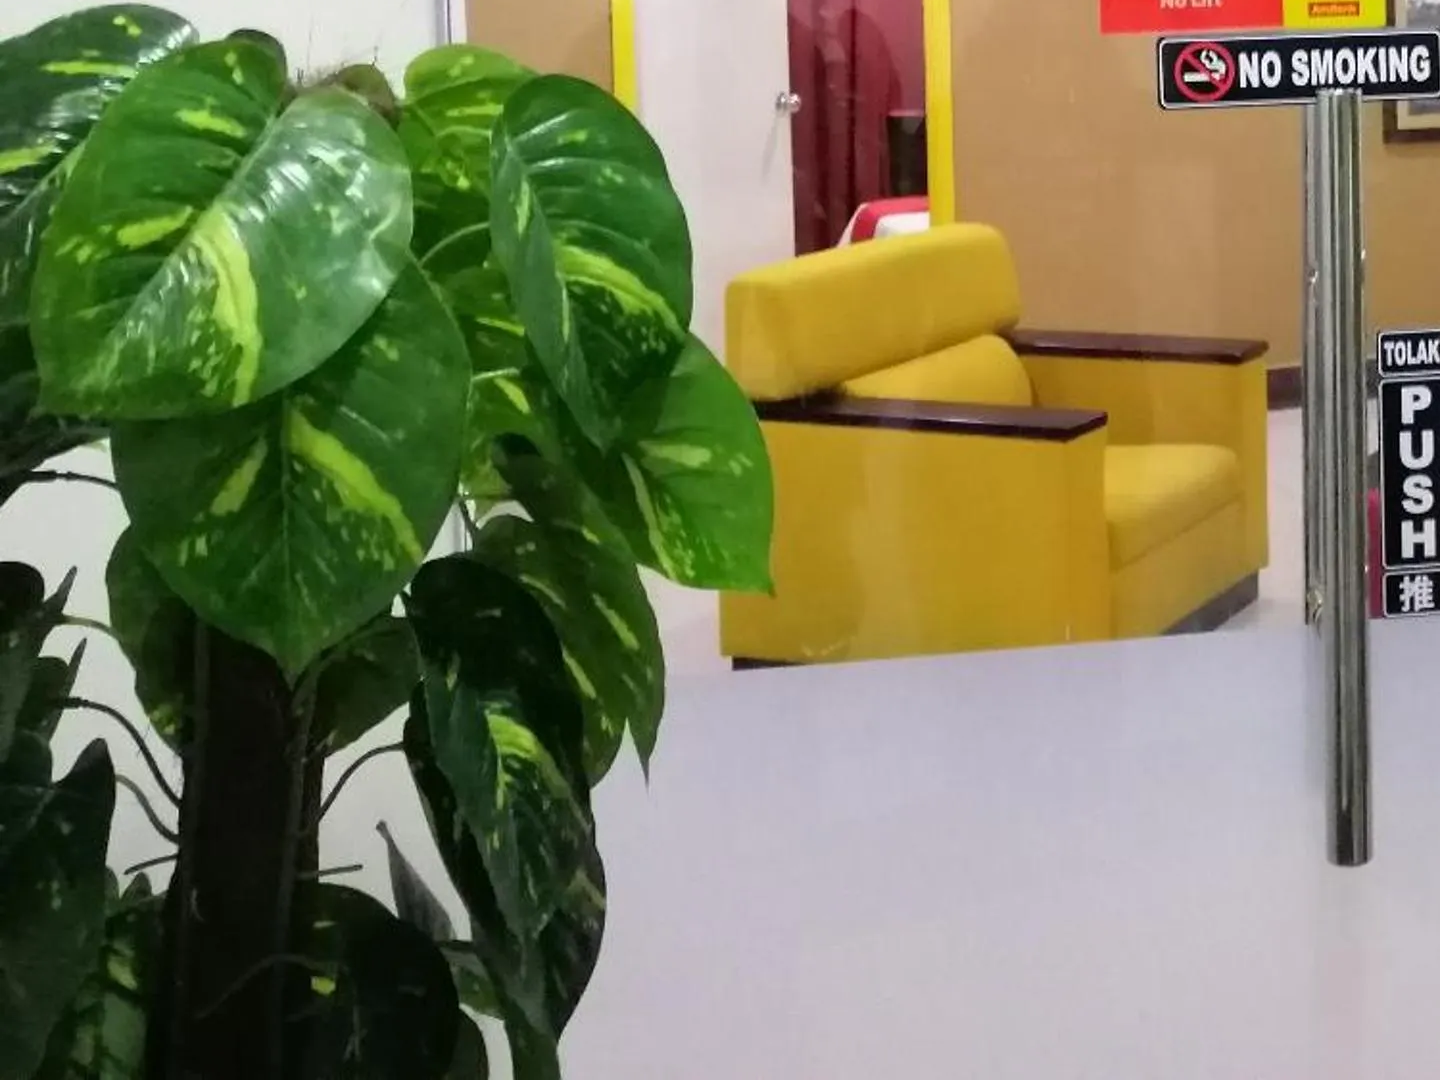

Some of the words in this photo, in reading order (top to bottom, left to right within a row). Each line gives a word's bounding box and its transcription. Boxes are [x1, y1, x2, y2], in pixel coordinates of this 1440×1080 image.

[1239, 51, 1281, 89] NO
[1290, 45, 1431, 86] SMOKING
[1384, 338, 1440, 367] TOLAK
[1399, 385, 1437, 559] PUSH
[1399, 575, 1435, 613] 推
